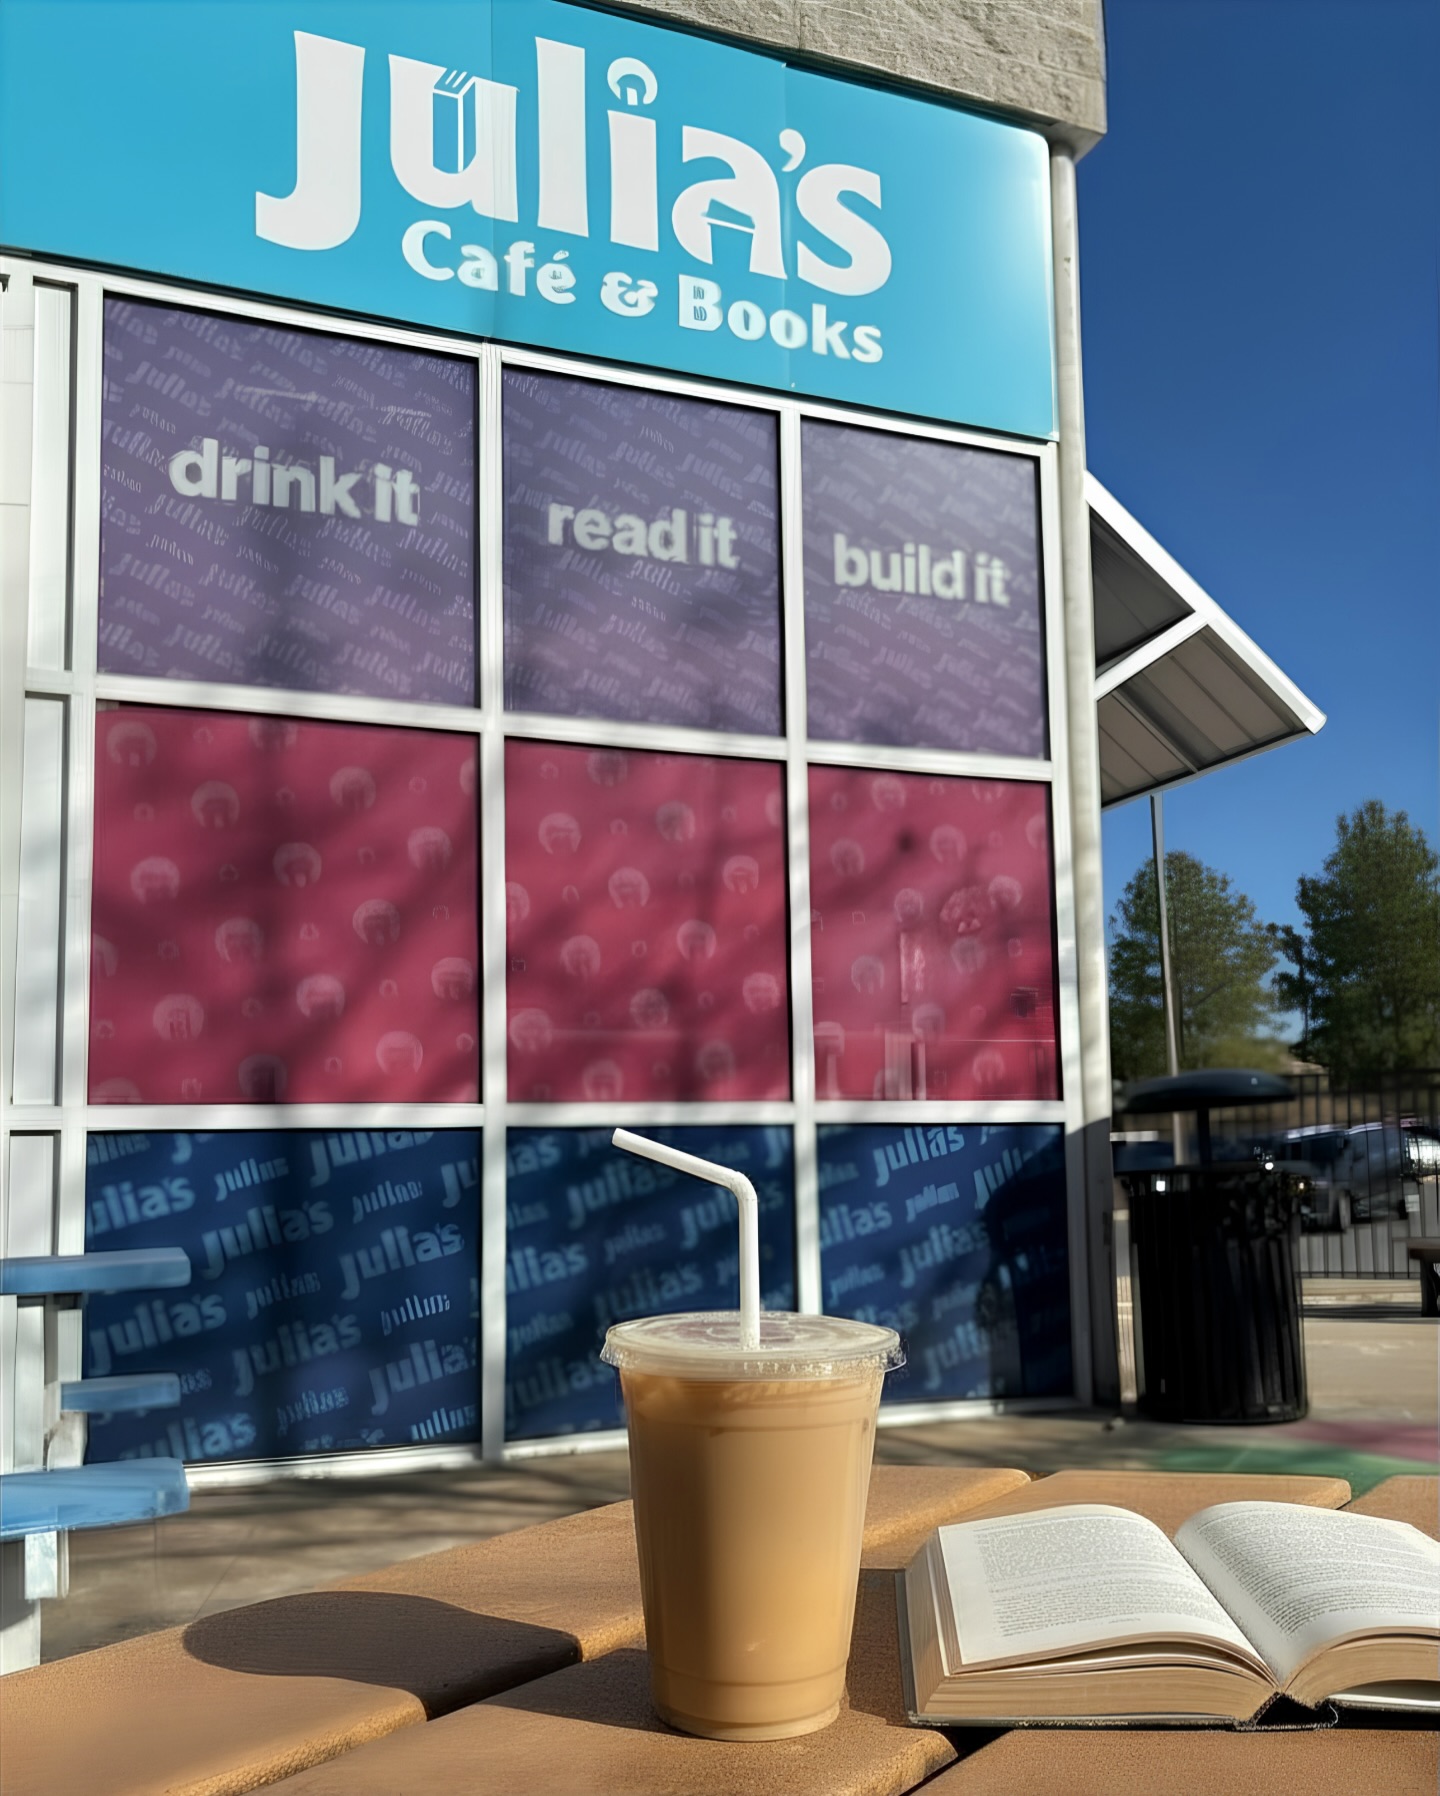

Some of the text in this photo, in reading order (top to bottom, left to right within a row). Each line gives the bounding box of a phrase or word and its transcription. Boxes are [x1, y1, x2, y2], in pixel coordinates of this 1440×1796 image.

[256, 30, 892, 297] Julia's
[401, 219, 884, 364] Café & Books
[168, 437, 363, 519] drink
[374, 463, 421, 527] it
[548, 502, 741, 569] read it
[833, 533, 1011, 609] build it
